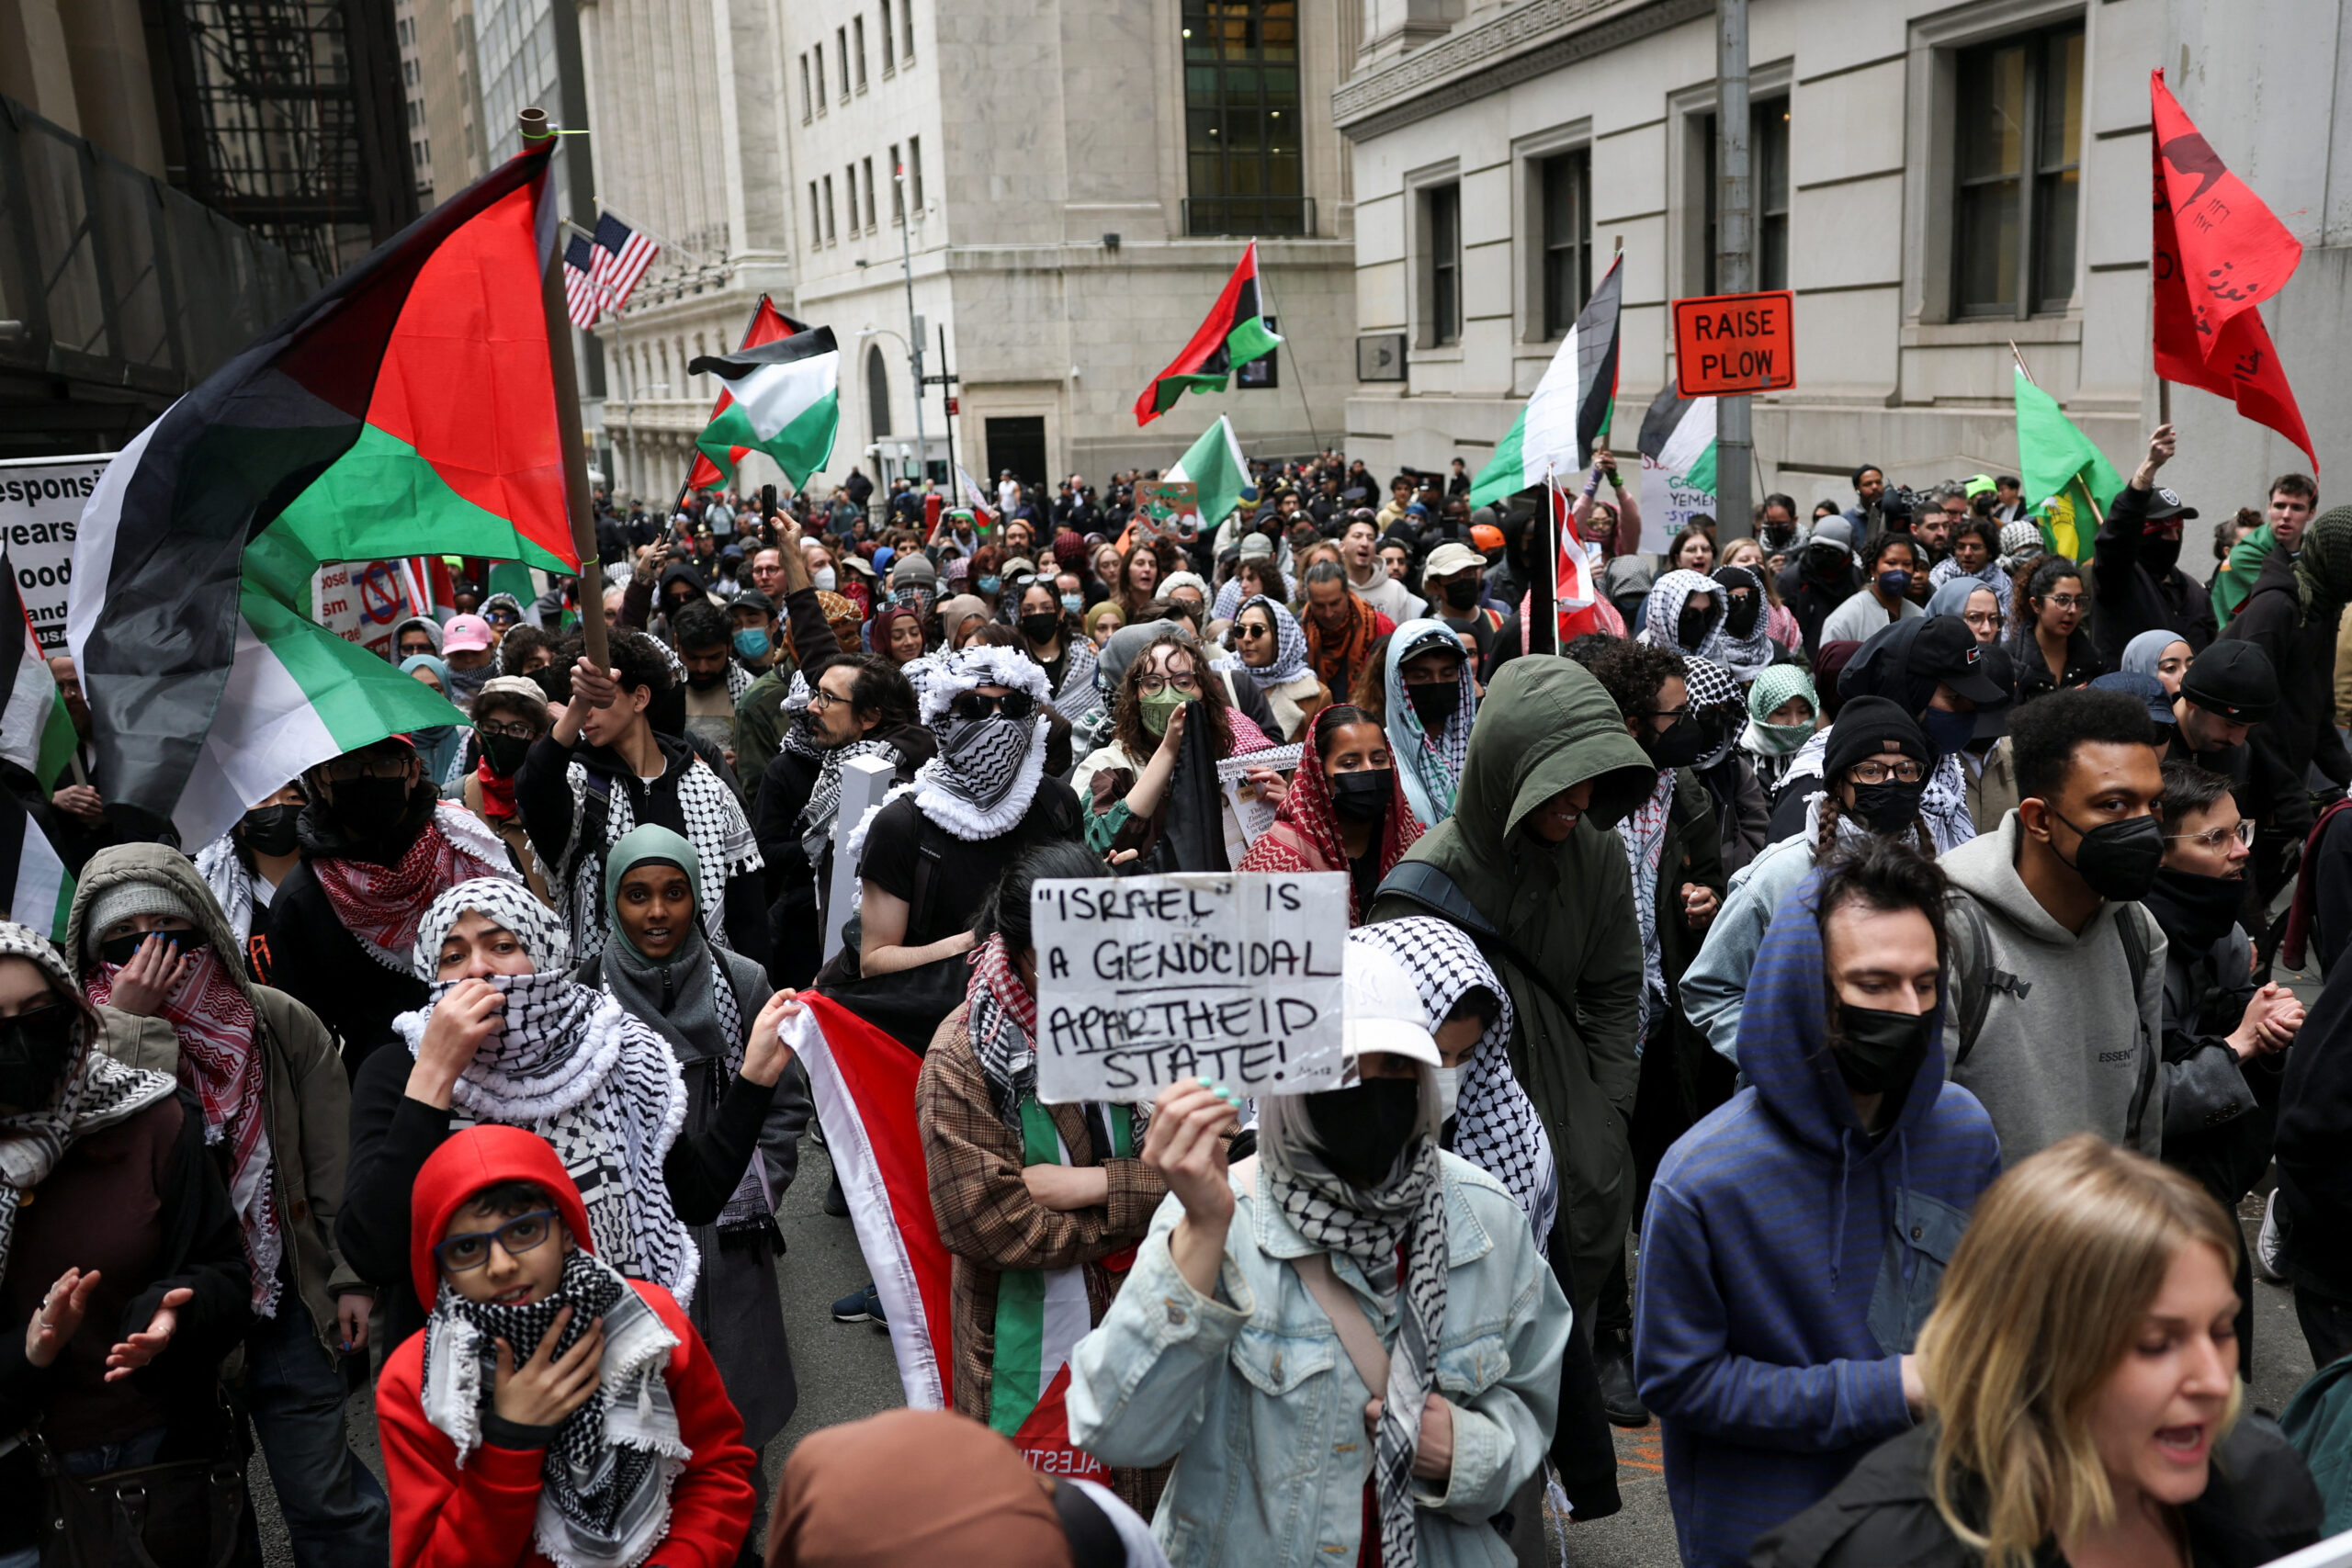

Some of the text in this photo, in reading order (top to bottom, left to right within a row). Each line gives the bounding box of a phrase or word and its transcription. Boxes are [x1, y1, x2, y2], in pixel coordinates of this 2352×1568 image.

[1695, 310, 1775, 341] RAISE
[1702, 350, 1773, 380] PLOW
[1038, 883, 1302, 921] "ISRAEL" IS
[1049, 939, 1343, 982] A GENOCIDAL
[1049, 998, 1317, 1056] APARTHEID
[1102, 1040, 1289, 1089] STATE!
